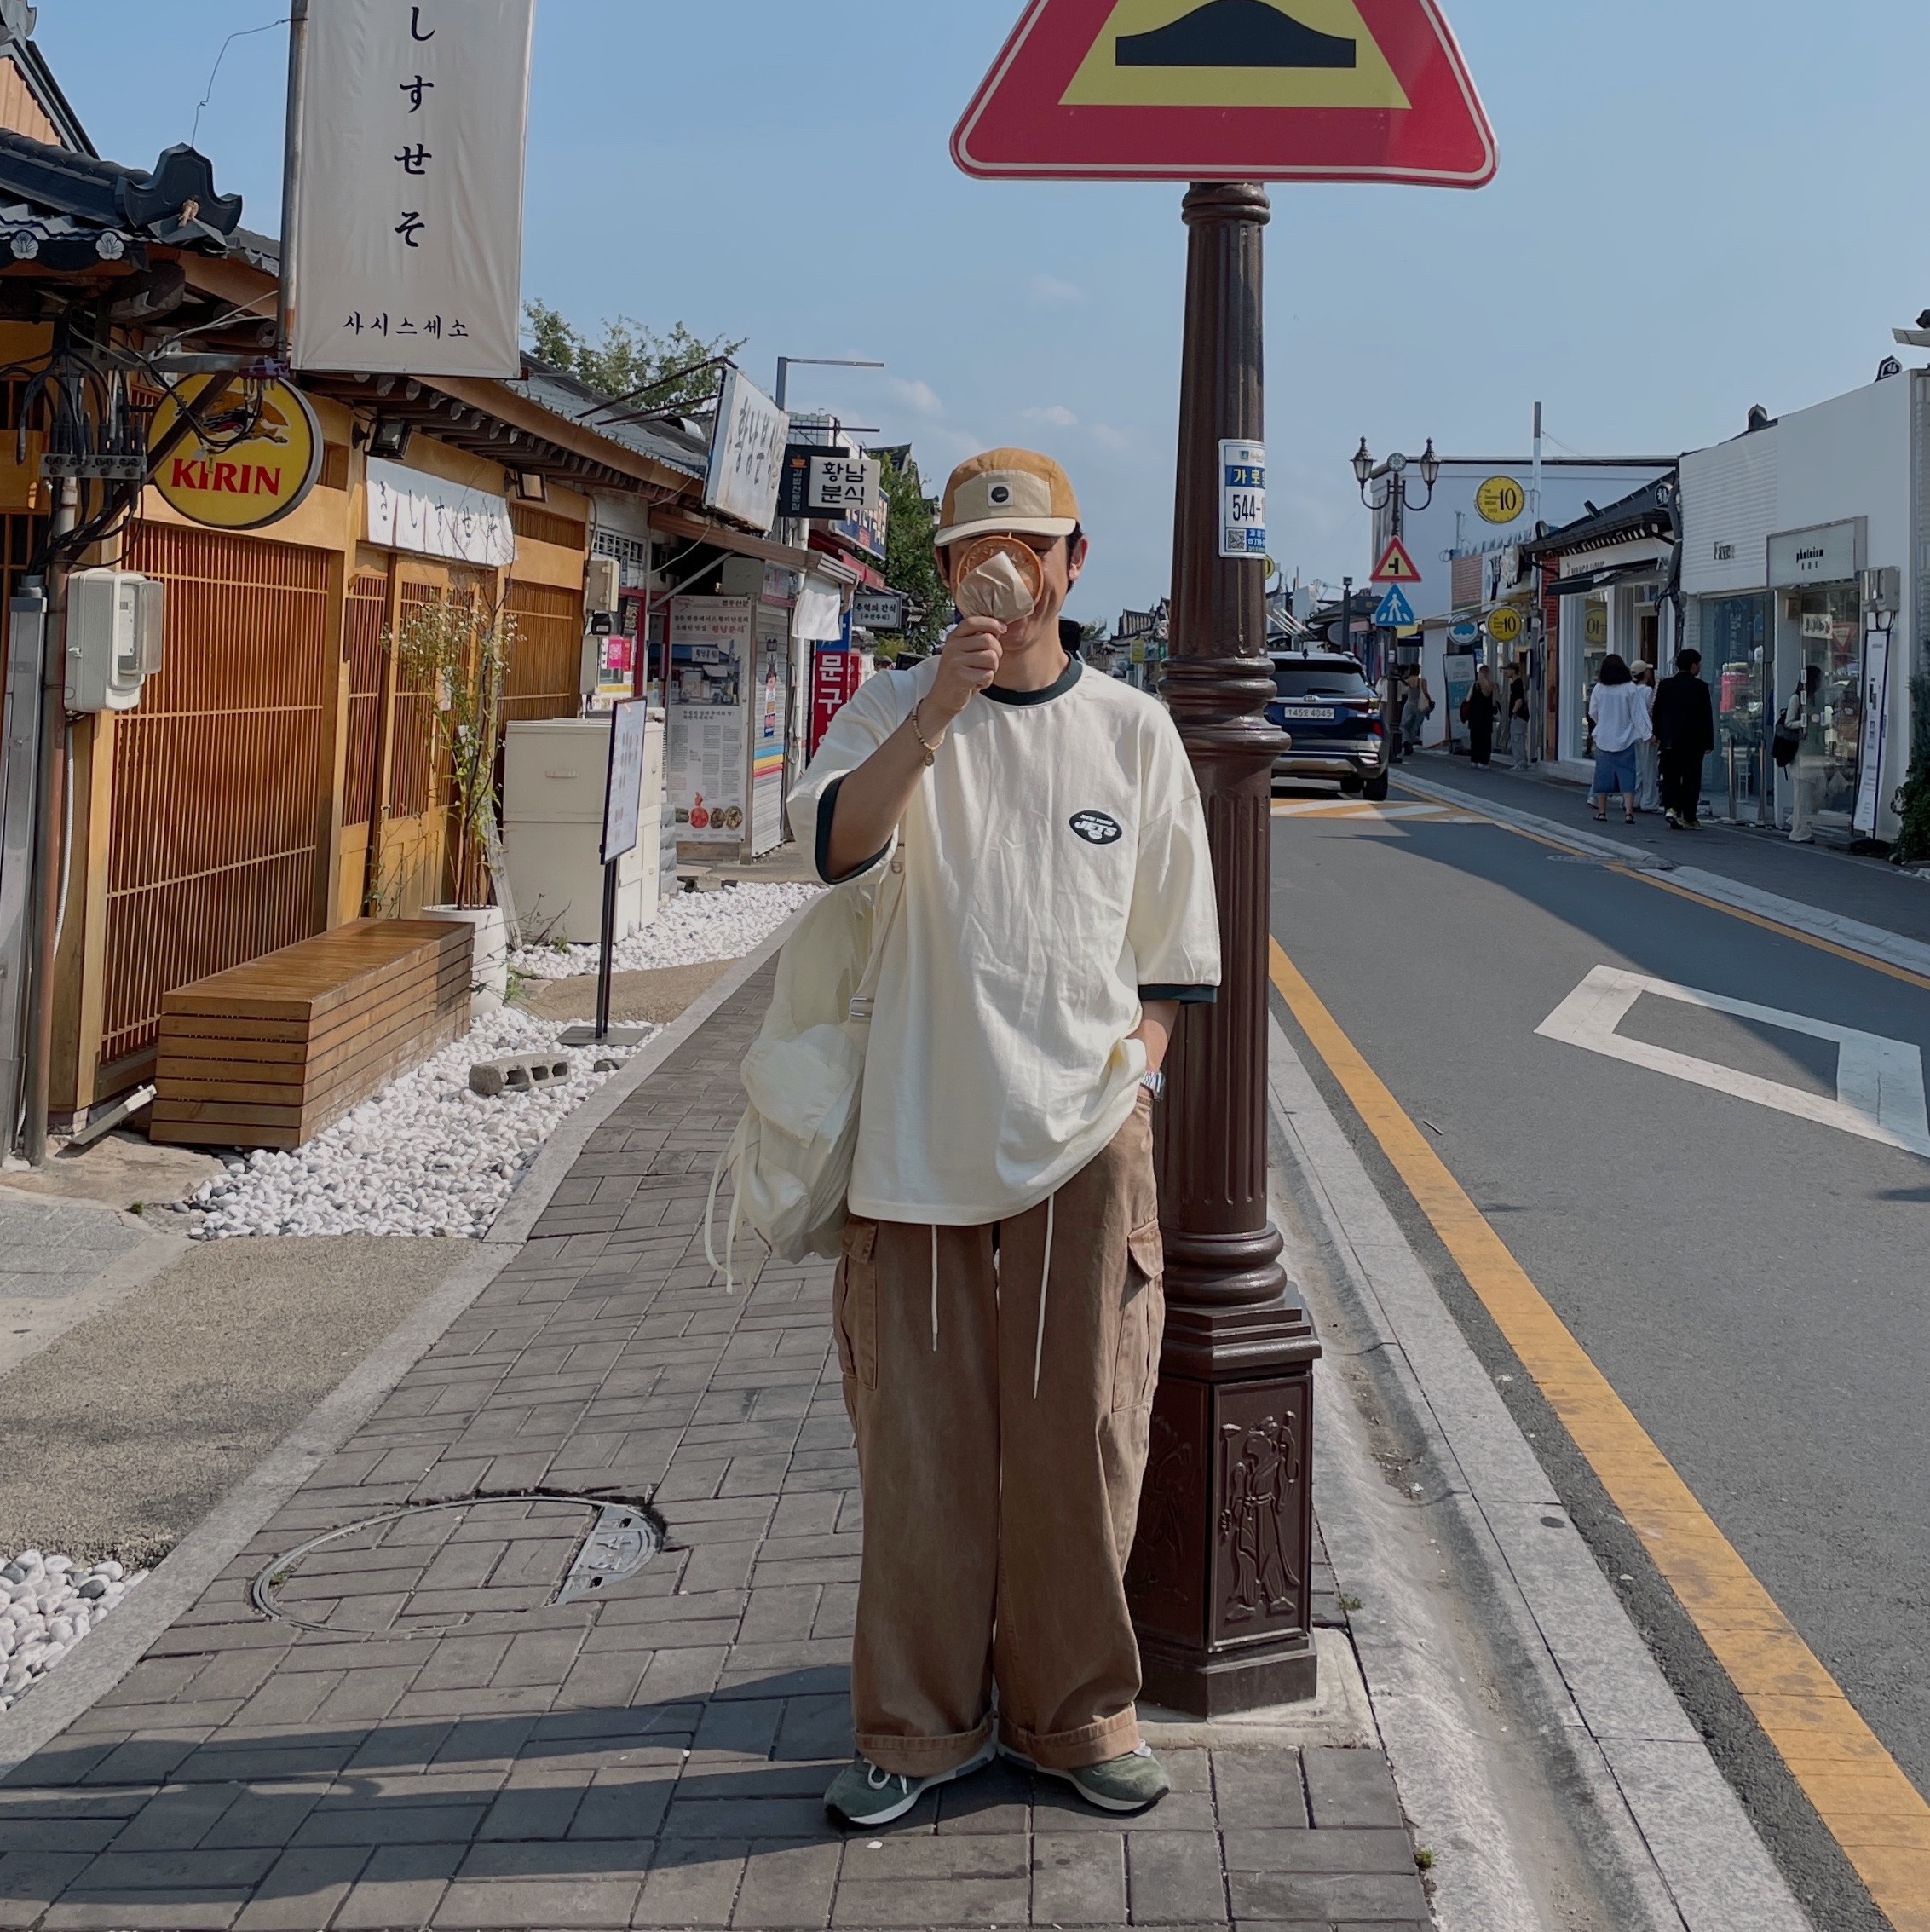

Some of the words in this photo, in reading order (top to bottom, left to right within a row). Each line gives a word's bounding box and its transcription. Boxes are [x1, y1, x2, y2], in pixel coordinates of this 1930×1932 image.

[394, 6, 435, 247] しすせそ
[343, 311, 469, 340] 사시스세소
[171, 458, 282, 496] KIRIN
[821, 461, 867, 483] 황남
[821, 484, 866, 505] 분식
[1499, 487, 1517, 510] 10
[856, 603, 879, 613] 추억의
[881, 603, 896, 614] 간식
[1503, 615, 1517, 633] 10
[1311, 709, 1333, 718] 4045
[1074, 820, 1117, 837] JETS
